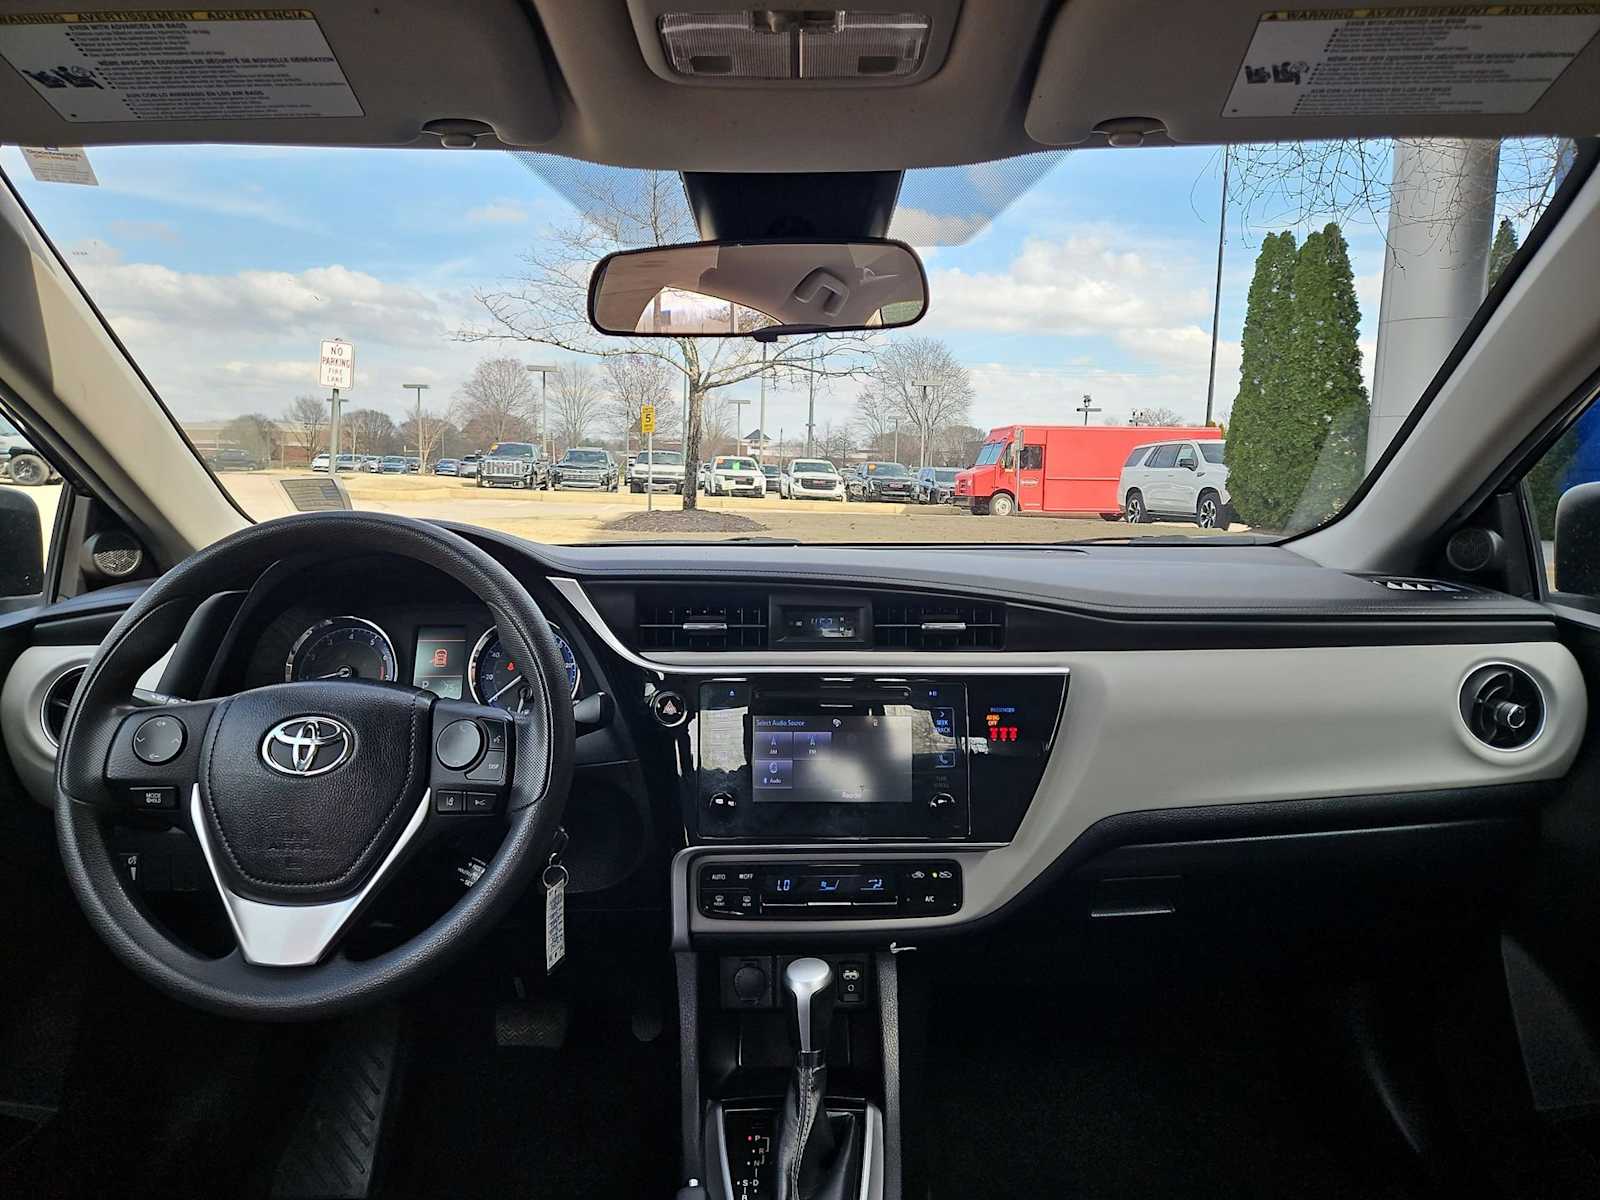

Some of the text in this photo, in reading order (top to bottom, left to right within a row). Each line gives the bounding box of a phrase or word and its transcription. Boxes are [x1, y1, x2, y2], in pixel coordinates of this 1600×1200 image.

[79, 11, 193, 22] AVERTISSEMENT
[208, 10, 305, 20] ADVERTENCIA
[1288, 9, 1353, 20] WARNING
[331, 347, 343, 357] NO
[322, 356, 350, 368] PARKING
[645, 413, 652, 423] 5
[711, 873, 726, 881] AUTO
[776, 879, 790, 892] LO
